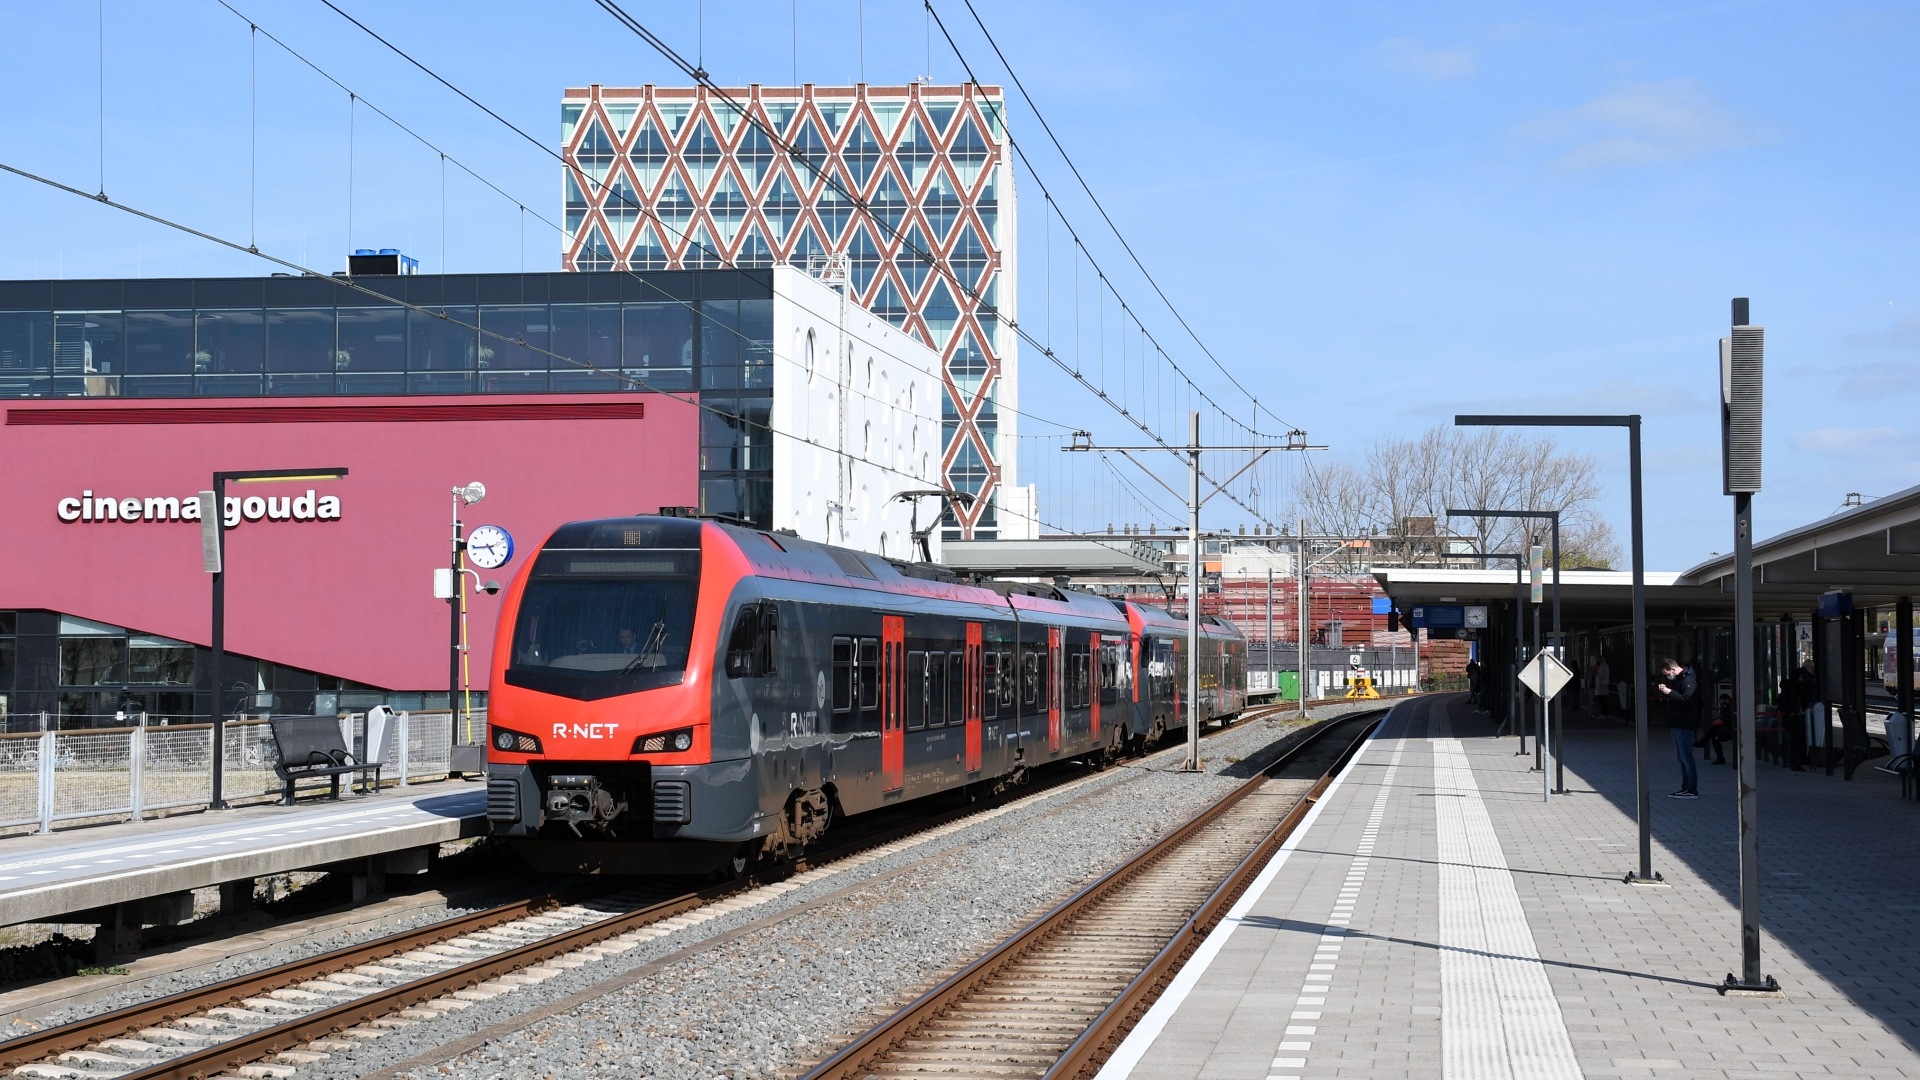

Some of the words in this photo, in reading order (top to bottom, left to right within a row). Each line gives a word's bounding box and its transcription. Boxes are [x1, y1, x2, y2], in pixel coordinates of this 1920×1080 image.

[58, 490, 201, 522] cinema
[224, 490, 341, 529] gouda
[853, 638, 858, 667] 2
[925, 651, 929, 677] 2
